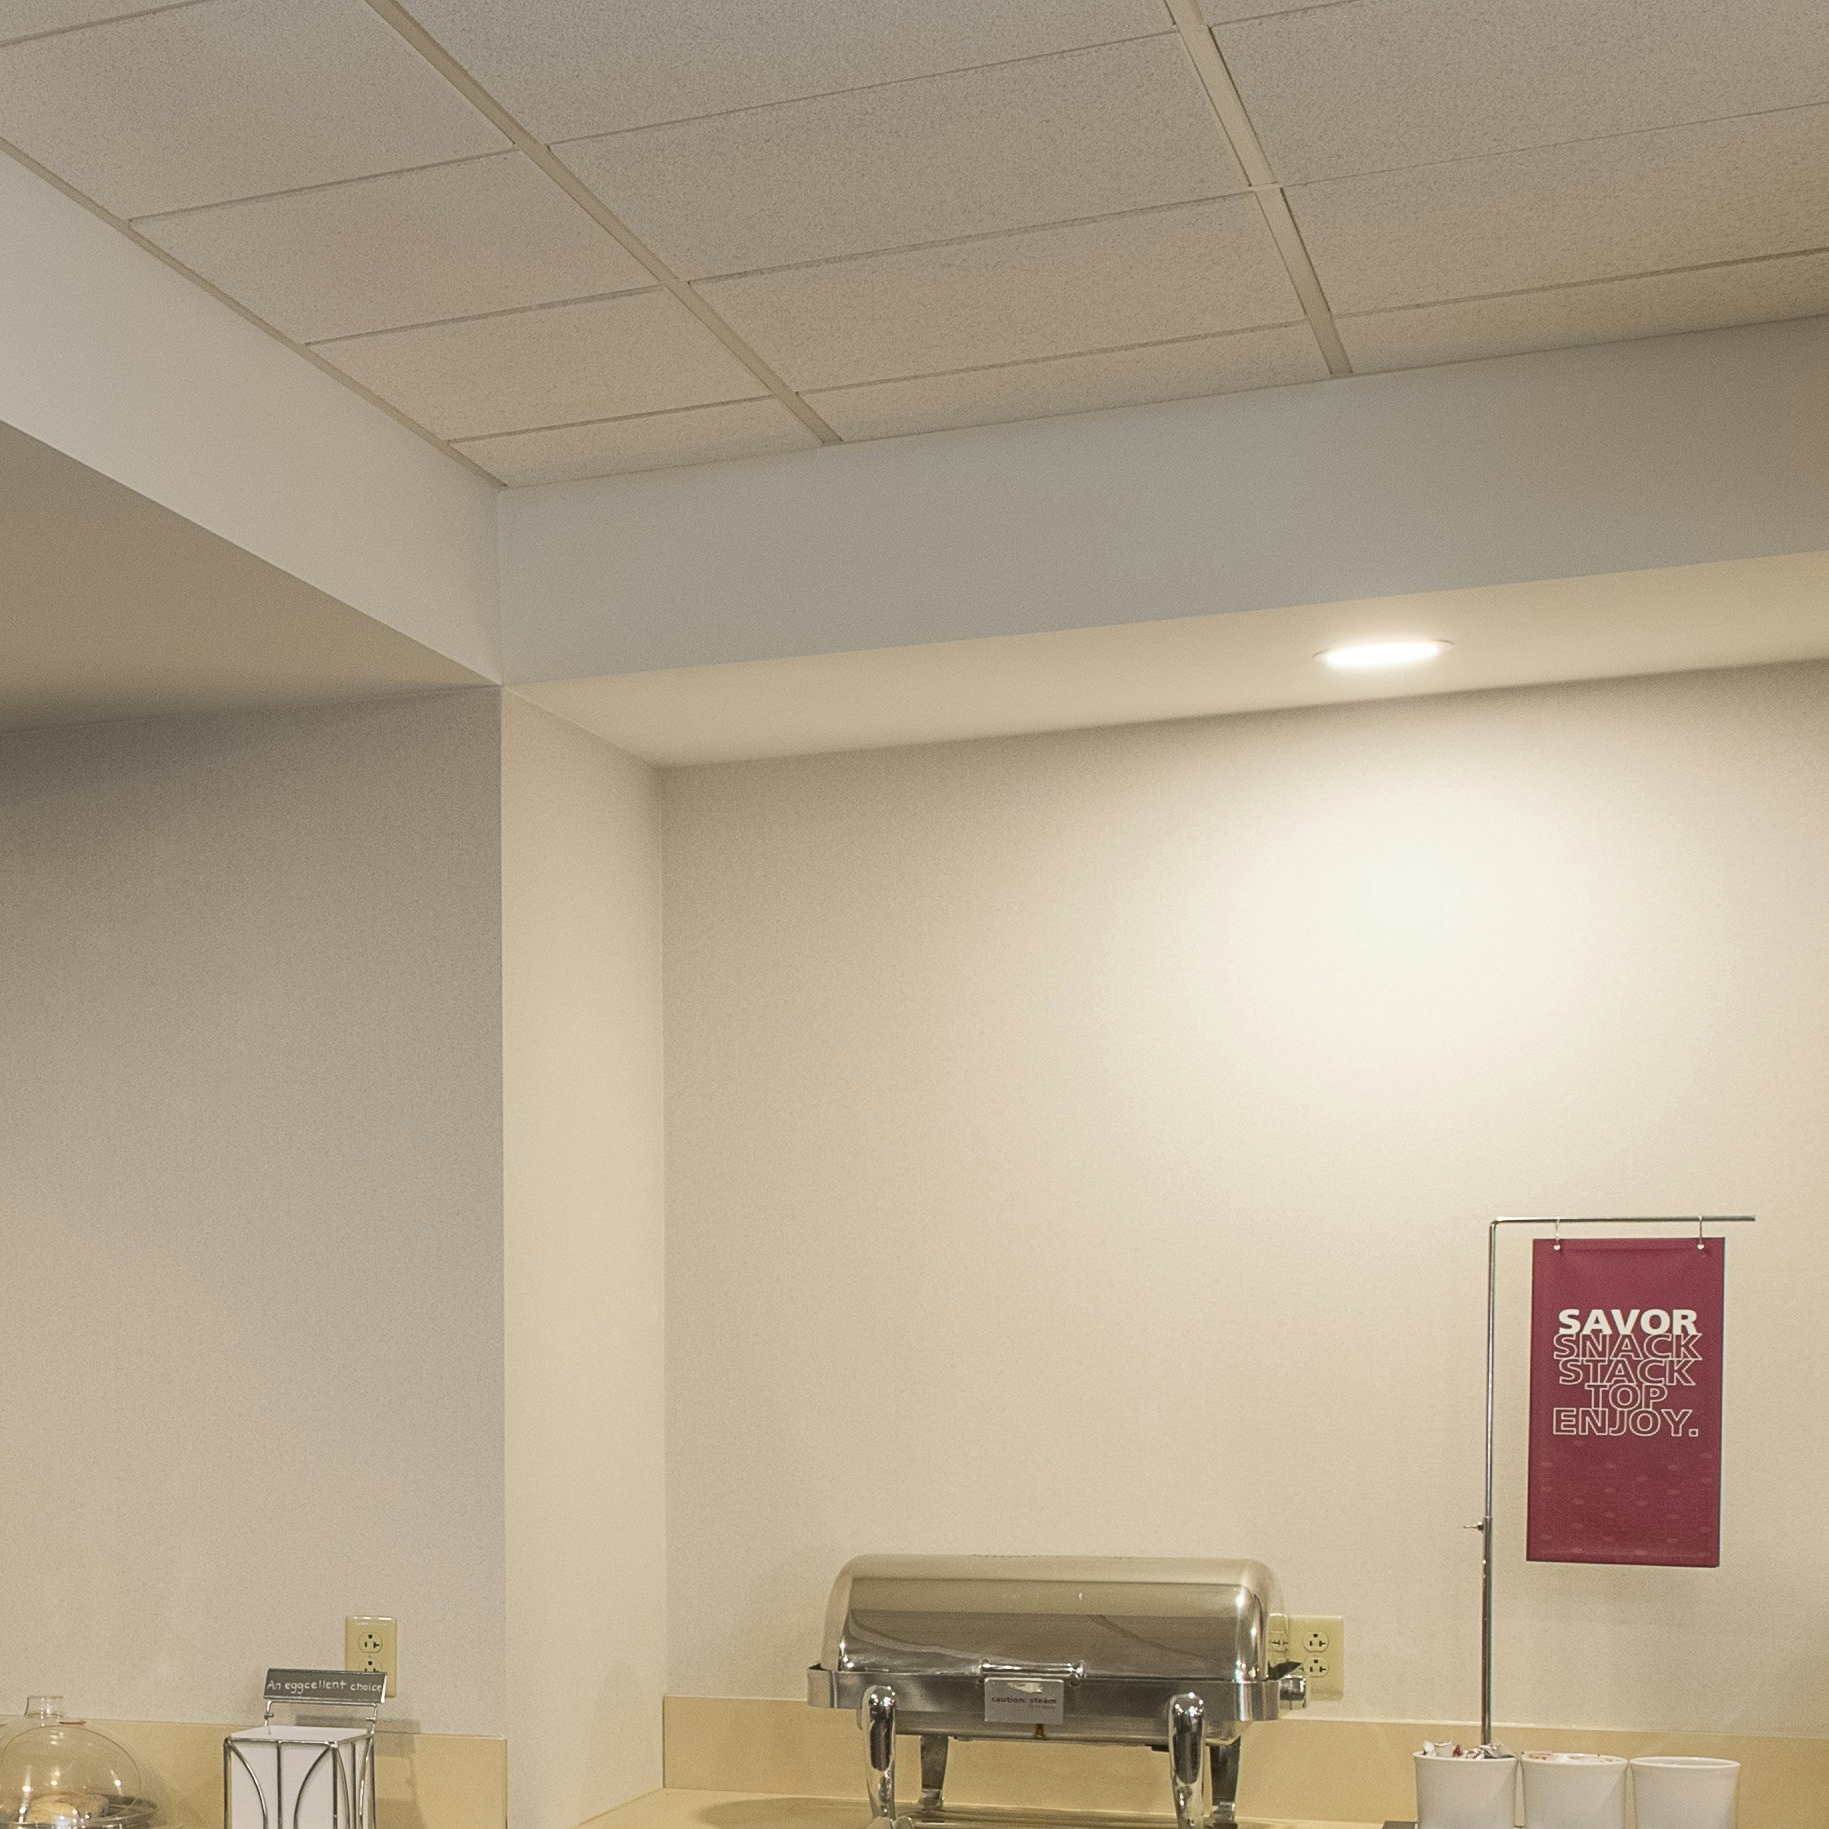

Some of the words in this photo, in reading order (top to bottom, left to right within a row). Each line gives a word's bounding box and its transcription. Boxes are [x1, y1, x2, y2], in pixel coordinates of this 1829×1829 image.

[1558, 1308, 1698, 1336] SAVOR
[1553, 1333, 1702, 1361] SNACK
[1559, 1358, 1697, 1386] STACK
[1585, 1383, 1668, 1411] TOP
[1553, 1408, 1699, 1437] ENJOY.
[267, 1680, 281, 1690] An
[284, 1679, 347, 1695] eggcellent
[350, 1682, 382, 1692] choice
